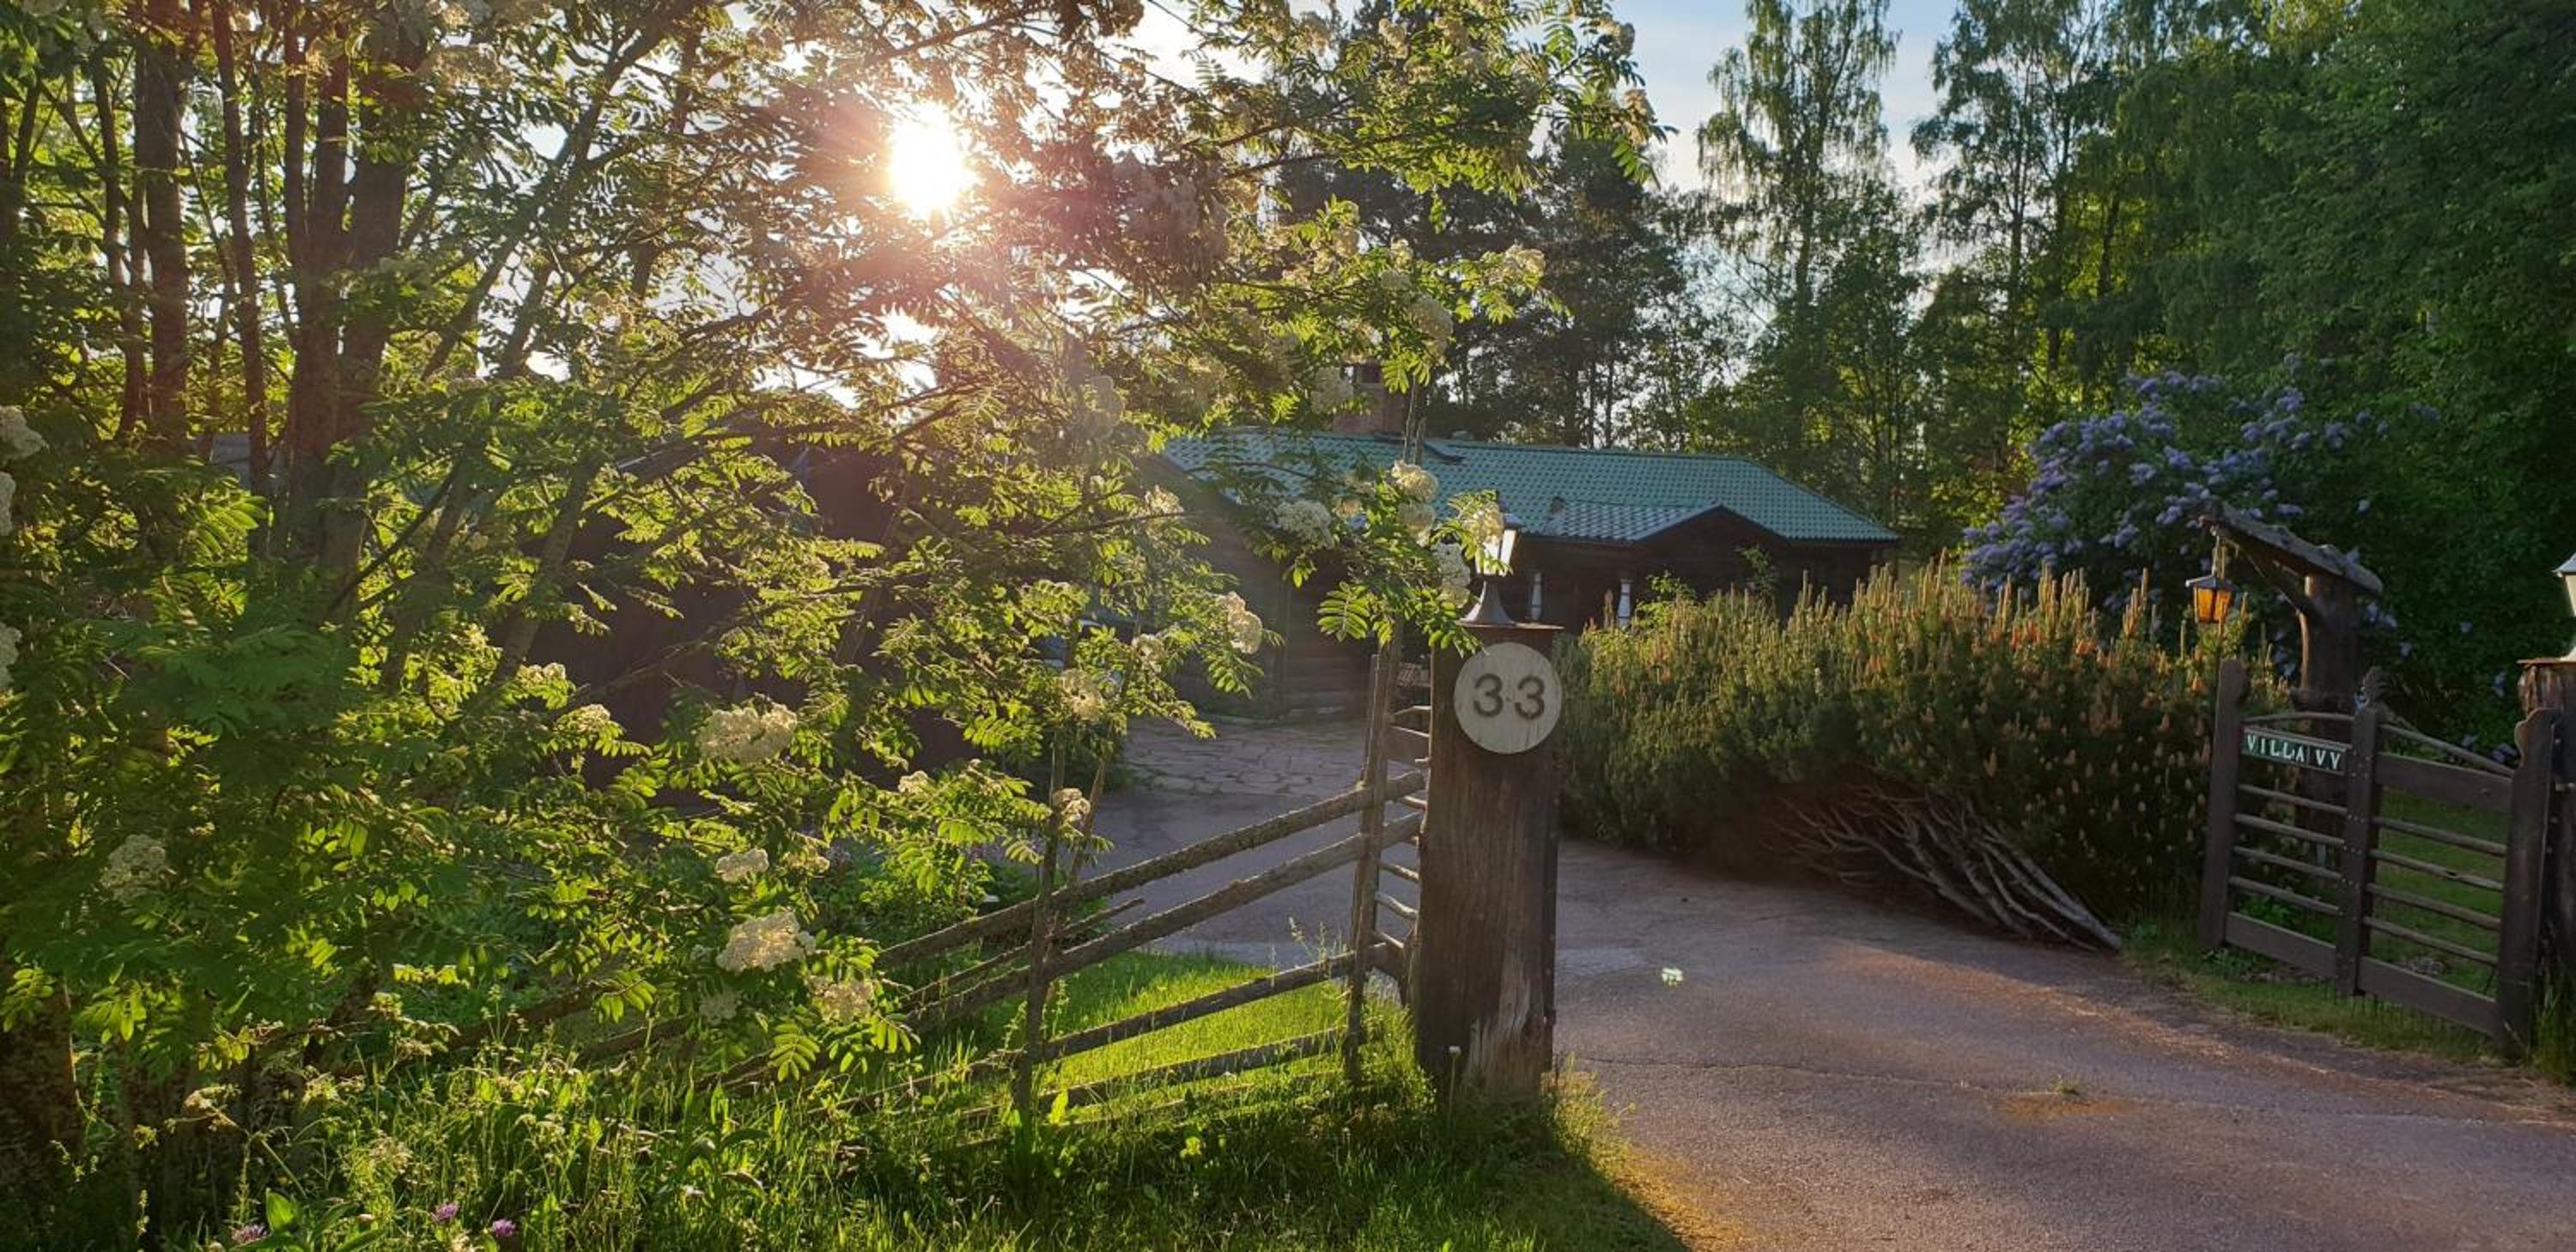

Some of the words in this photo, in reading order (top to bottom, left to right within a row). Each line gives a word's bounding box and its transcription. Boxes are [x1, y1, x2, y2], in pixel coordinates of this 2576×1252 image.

[1473, 673, 1546, 720] 33
[2247, 734, 2305, 763] VILLA
[2316, 749, 2342, 770] VY
